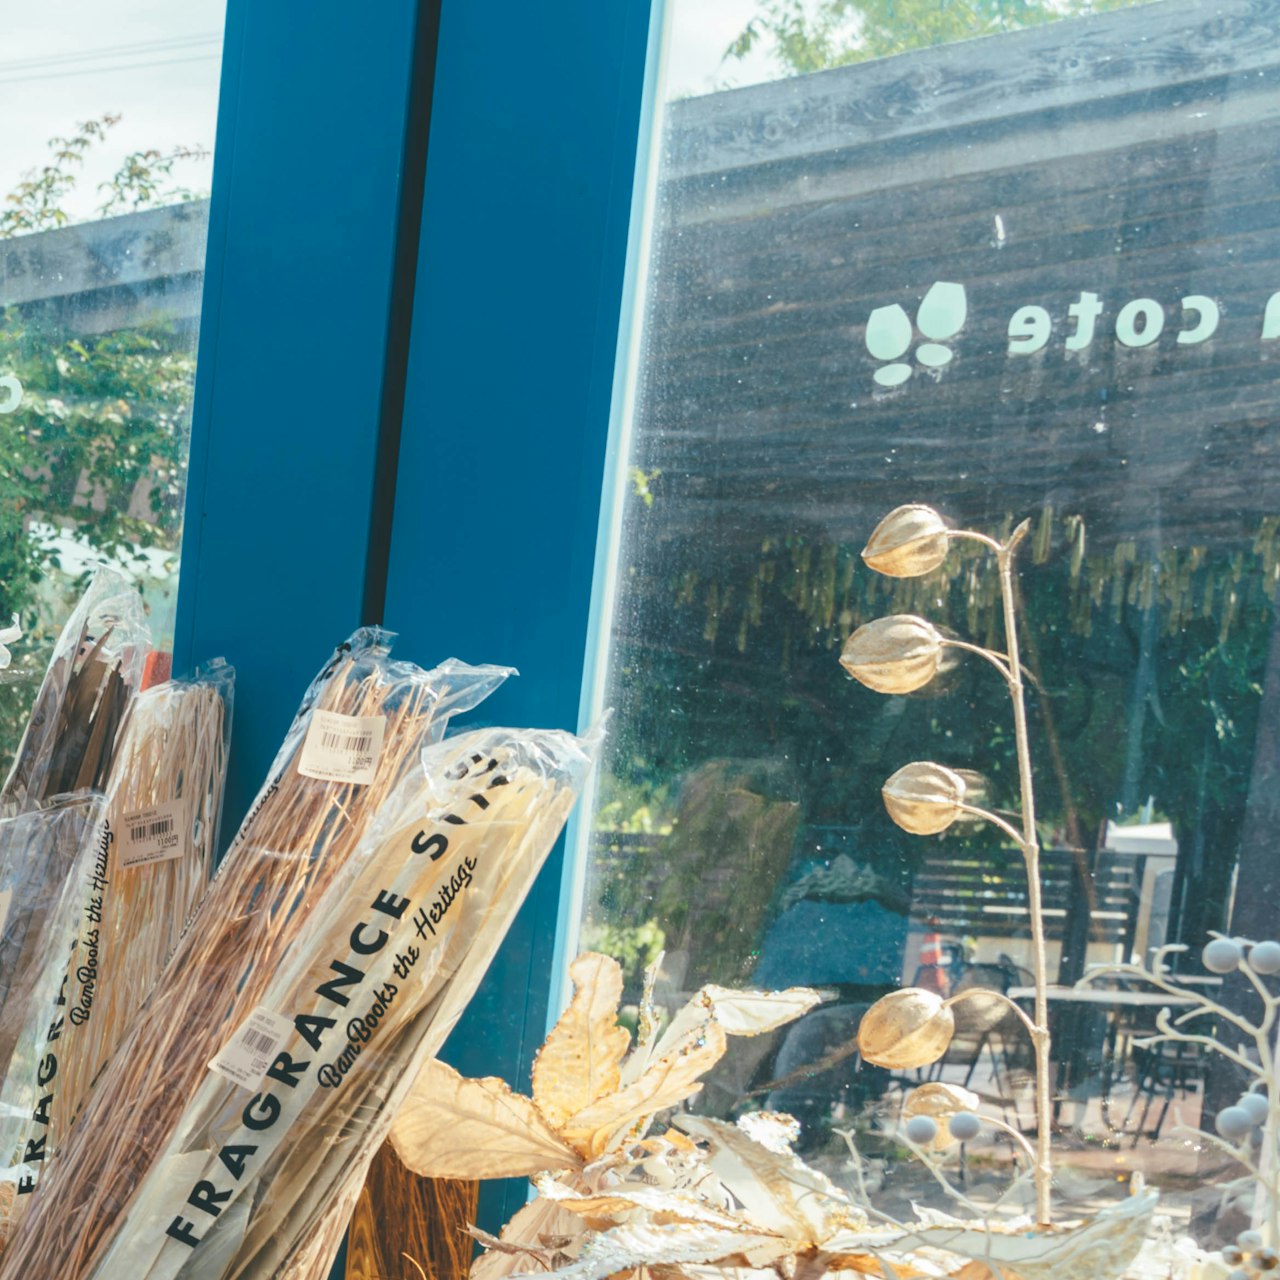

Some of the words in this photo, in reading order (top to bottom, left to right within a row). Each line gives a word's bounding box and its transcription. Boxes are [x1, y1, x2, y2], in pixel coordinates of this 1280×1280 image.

[89, 896, 103, 924] the
[317, 981, 399, 1090] BamBooks
[392, 945, 421, 985] the
[415, 855, 478, 943] Heritage
[165, 888, 412, 1249] FRAGRANCE
